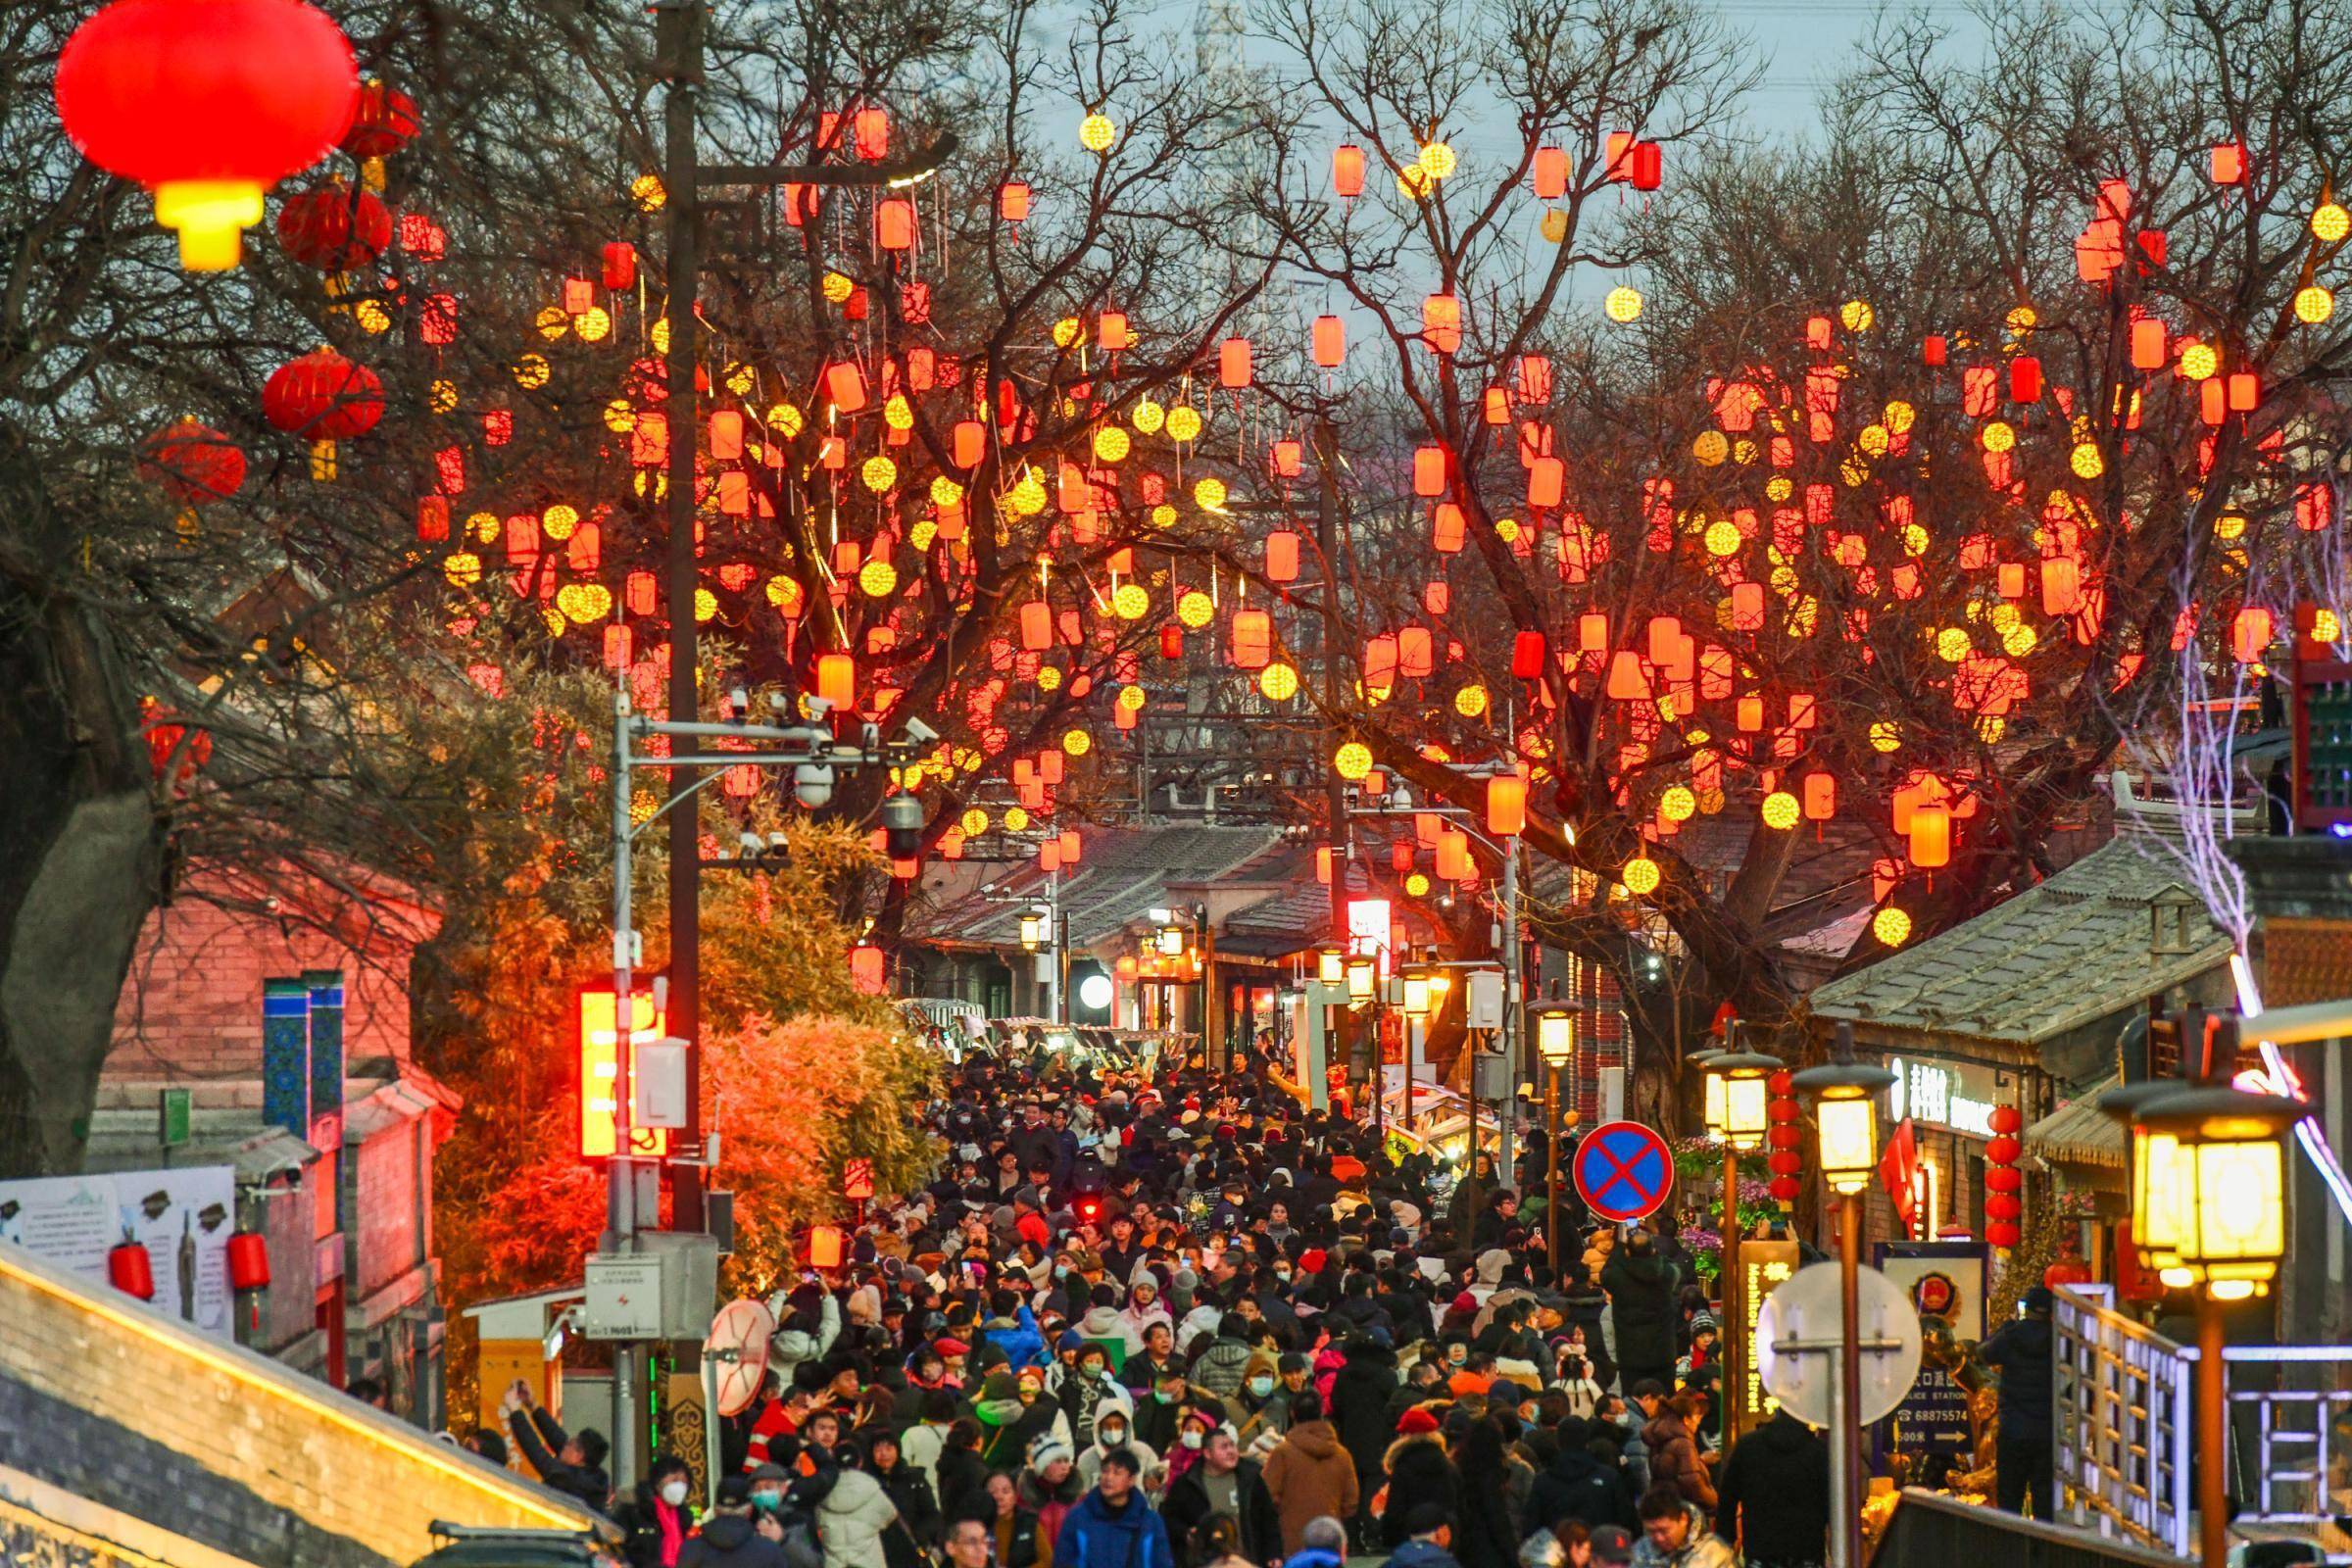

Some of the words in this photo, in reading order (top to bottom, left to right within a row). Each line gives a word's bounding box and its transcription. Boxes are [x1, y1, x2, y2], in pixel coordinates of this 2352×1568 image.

[1748, 1262, 1761, 1328] Moshikou
[1748, 1373, 1761, 1413] Street
[1933, 1392, 1968, 1401] STATION
[1915, 1410, 1968, 1422] 68875574
